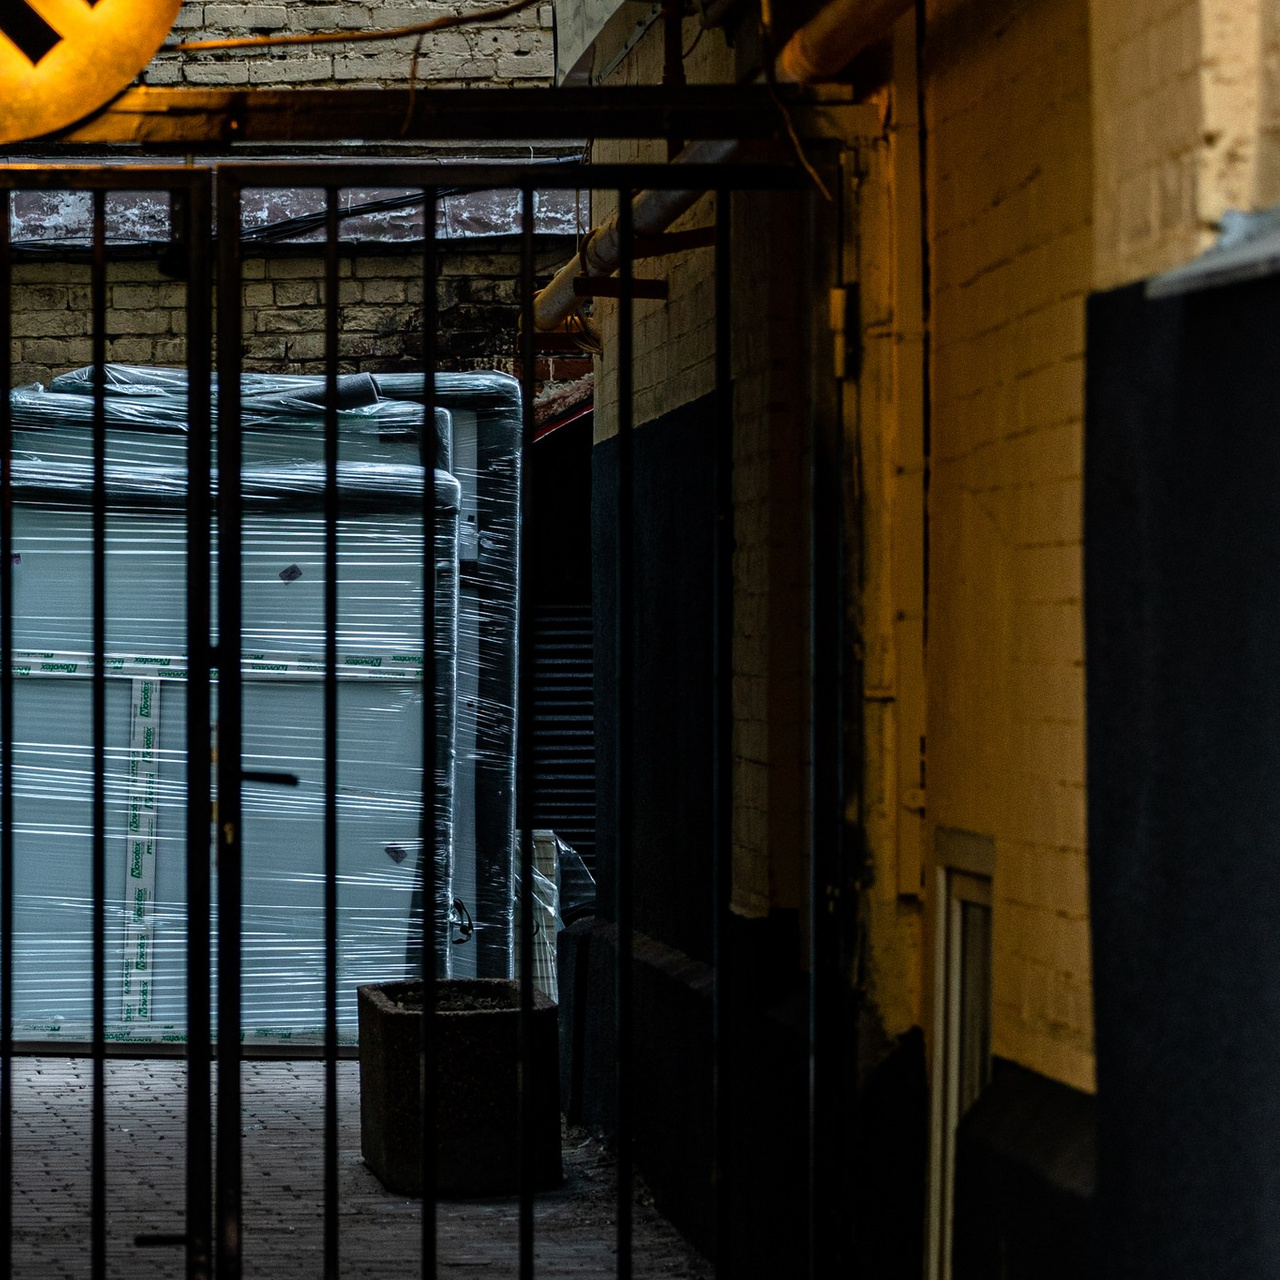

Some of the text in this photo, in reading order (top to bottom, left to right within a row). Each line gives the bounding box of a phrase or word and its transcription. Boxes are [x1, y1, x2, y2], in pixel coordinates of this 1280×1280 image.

[40, 663, 78, 673] Novotex
[139, 681, 152, 717] Novotex
[131, 842, 142, 878] Novotex
